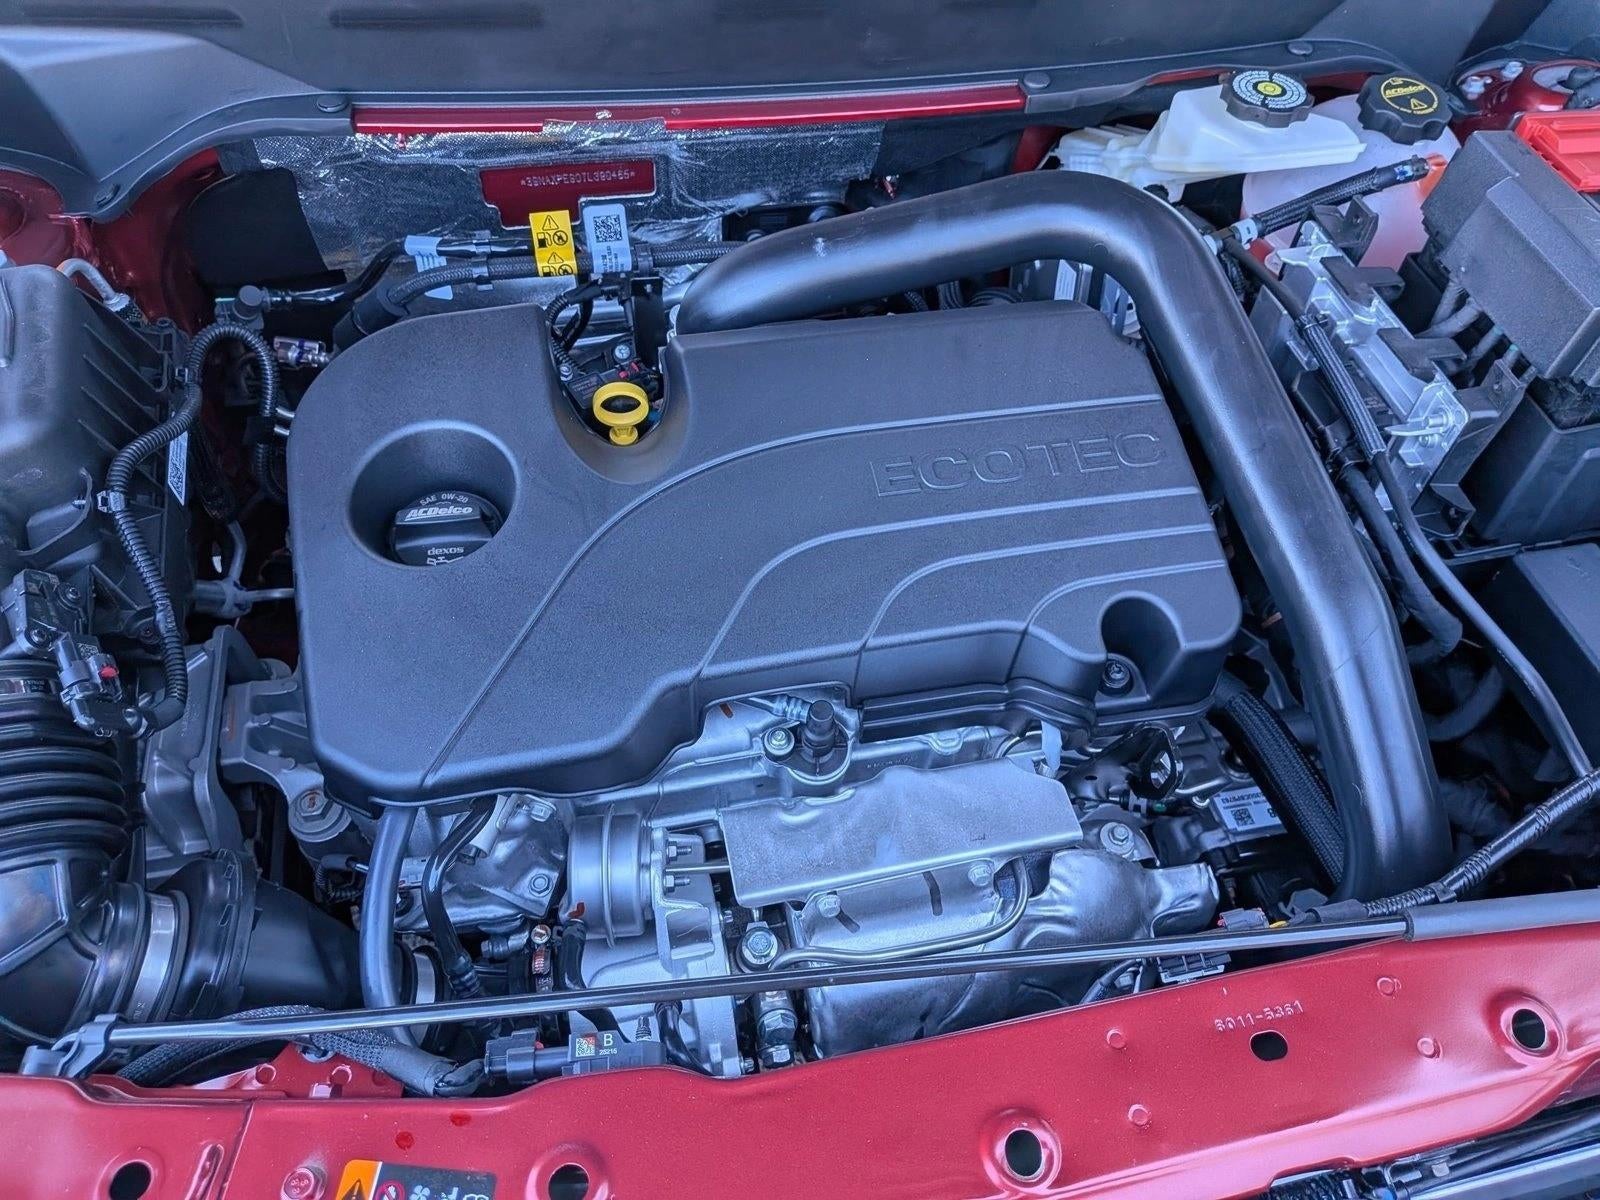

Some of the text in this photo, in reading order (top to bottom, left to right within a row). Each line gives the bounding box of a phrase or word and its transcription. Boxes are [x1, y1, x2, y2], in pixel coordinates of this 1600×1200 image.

[1385, 84, 1425, 97] ACDelco
[869, 433, 1164, 497] ECOTEC
[420, 493, 469, 506] SAE 0W-20
[404, 505, 473, 521] ACDelco
[427, 546, 465, 556] dexos
[603, 1033, 614, 1047] B
